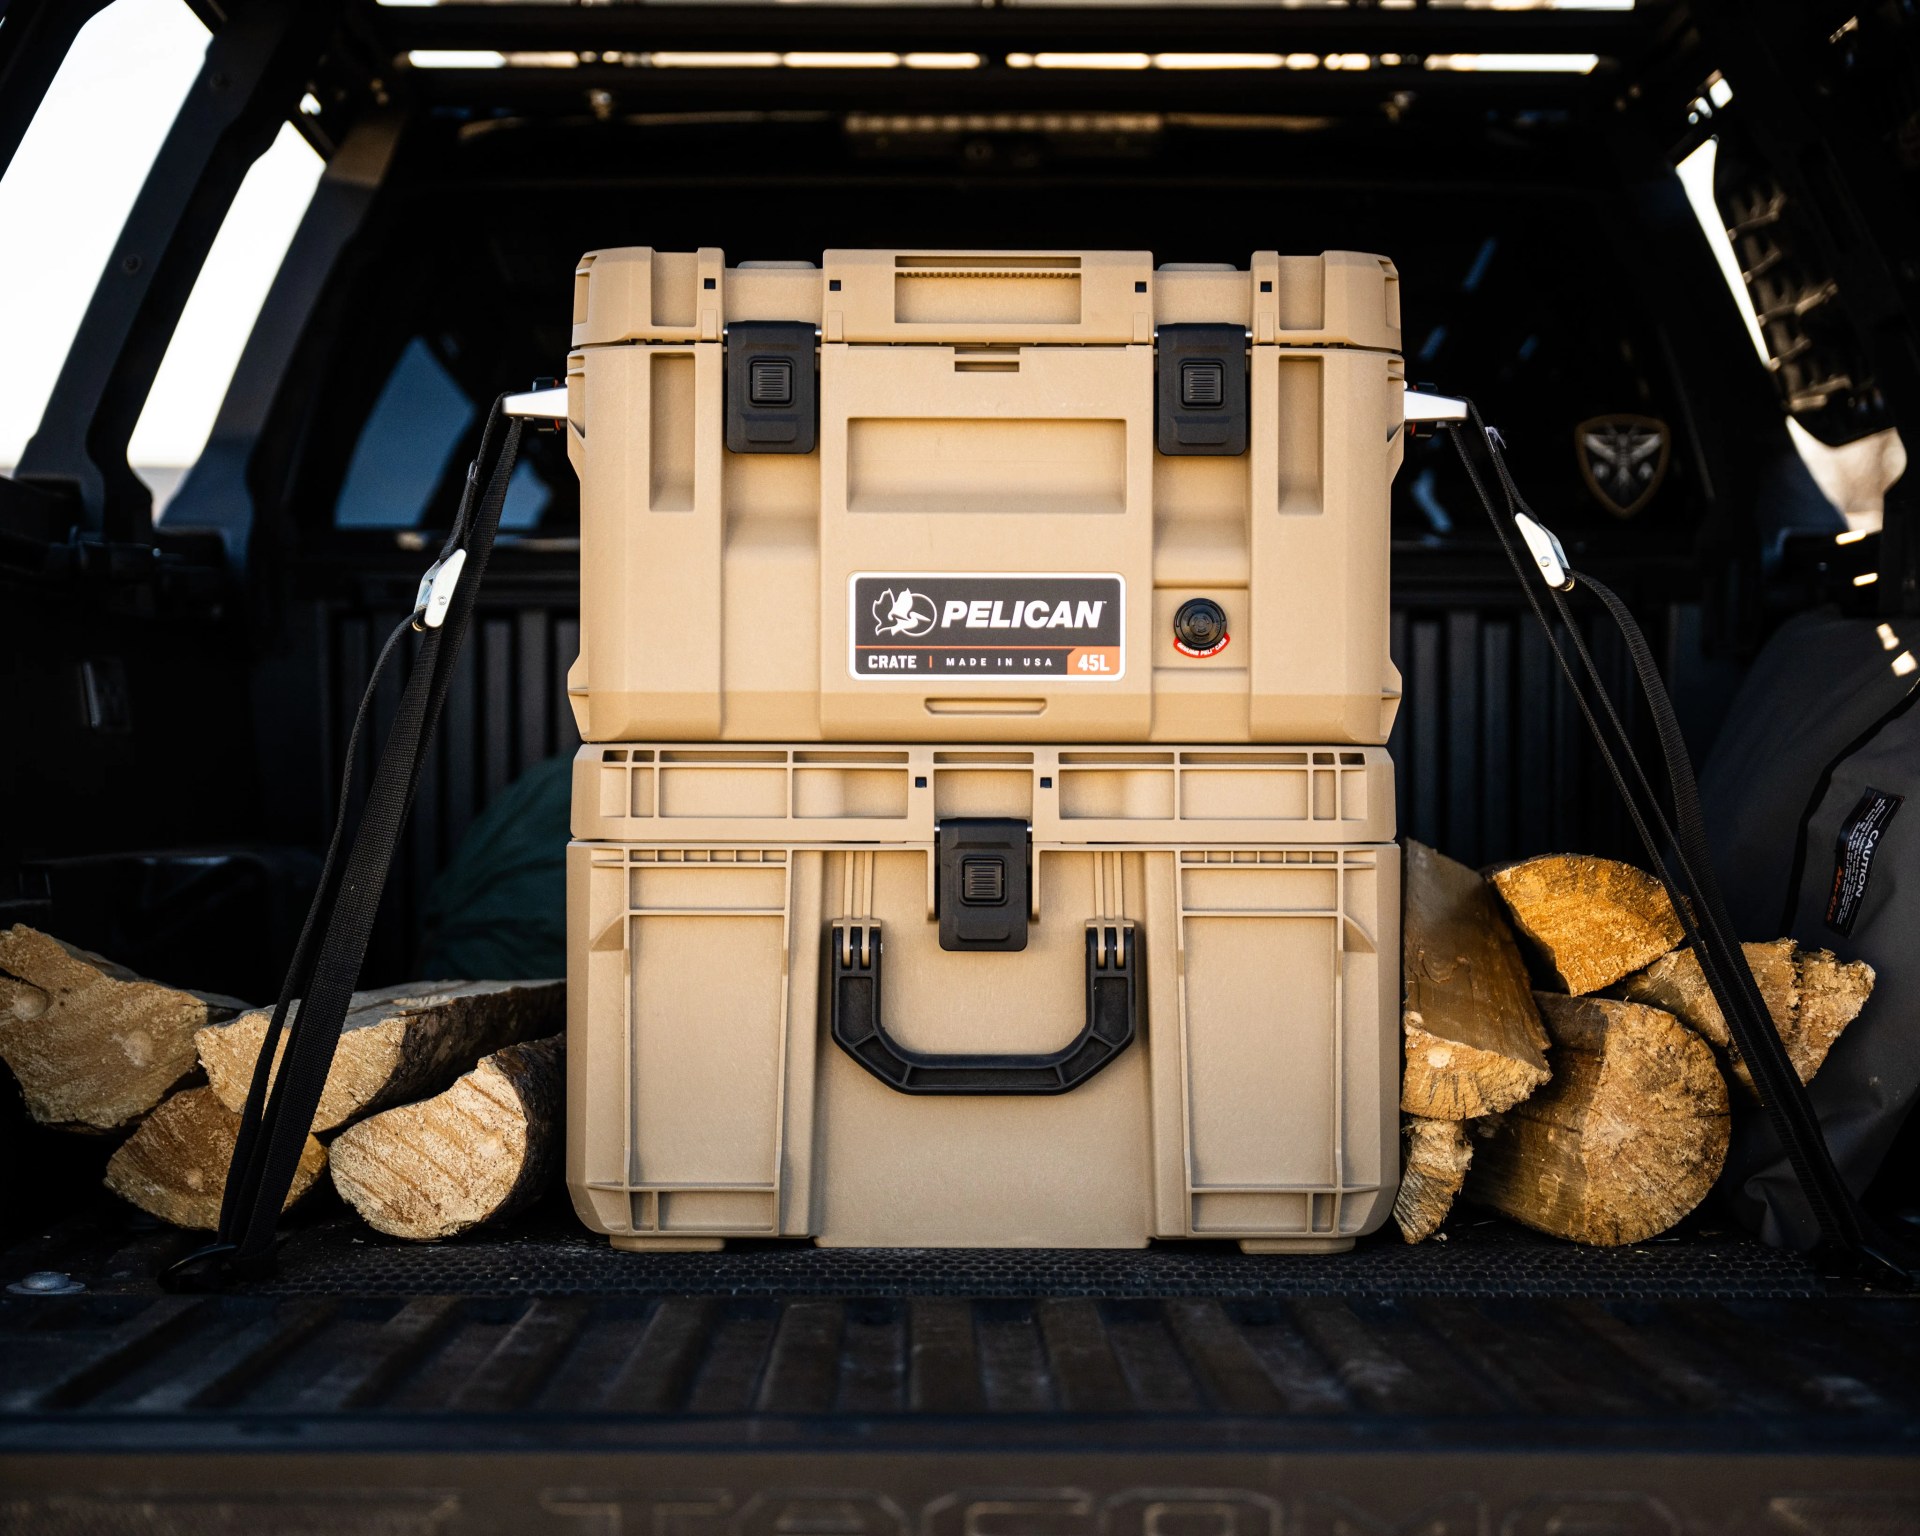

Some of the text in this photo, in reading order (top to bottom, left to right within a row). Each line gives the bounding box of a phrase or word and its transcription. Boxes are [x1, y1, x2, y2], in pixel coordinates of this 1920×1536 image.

[868, 654, 1110, 671] CRATE MADE IN USA 45L
[1855, 829, 1879, 898] CAUTION
